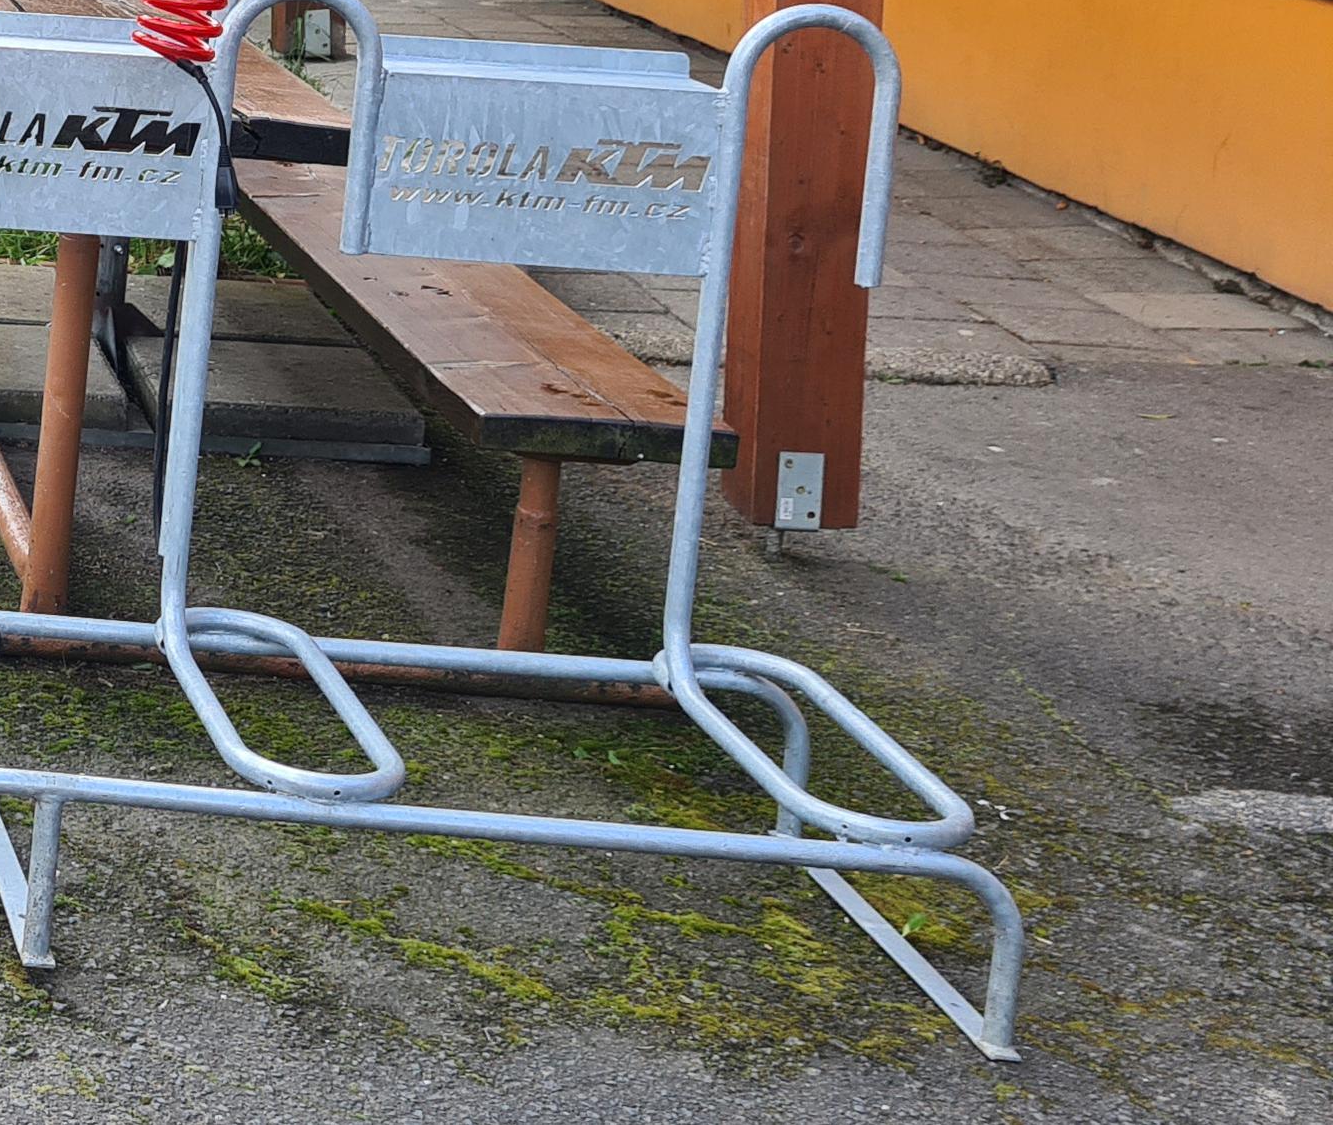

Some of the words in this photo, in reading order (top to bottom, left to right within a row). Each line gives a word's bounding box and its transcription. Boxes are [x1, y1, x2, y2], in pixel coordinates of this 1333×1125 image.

[51, 106, 202, 158] KTM
[378, 135, 550, 182] TOROLA
[555, 138, 712, 193] KTM
[389, 184, 691, 220] www.ktm-fm.cz
